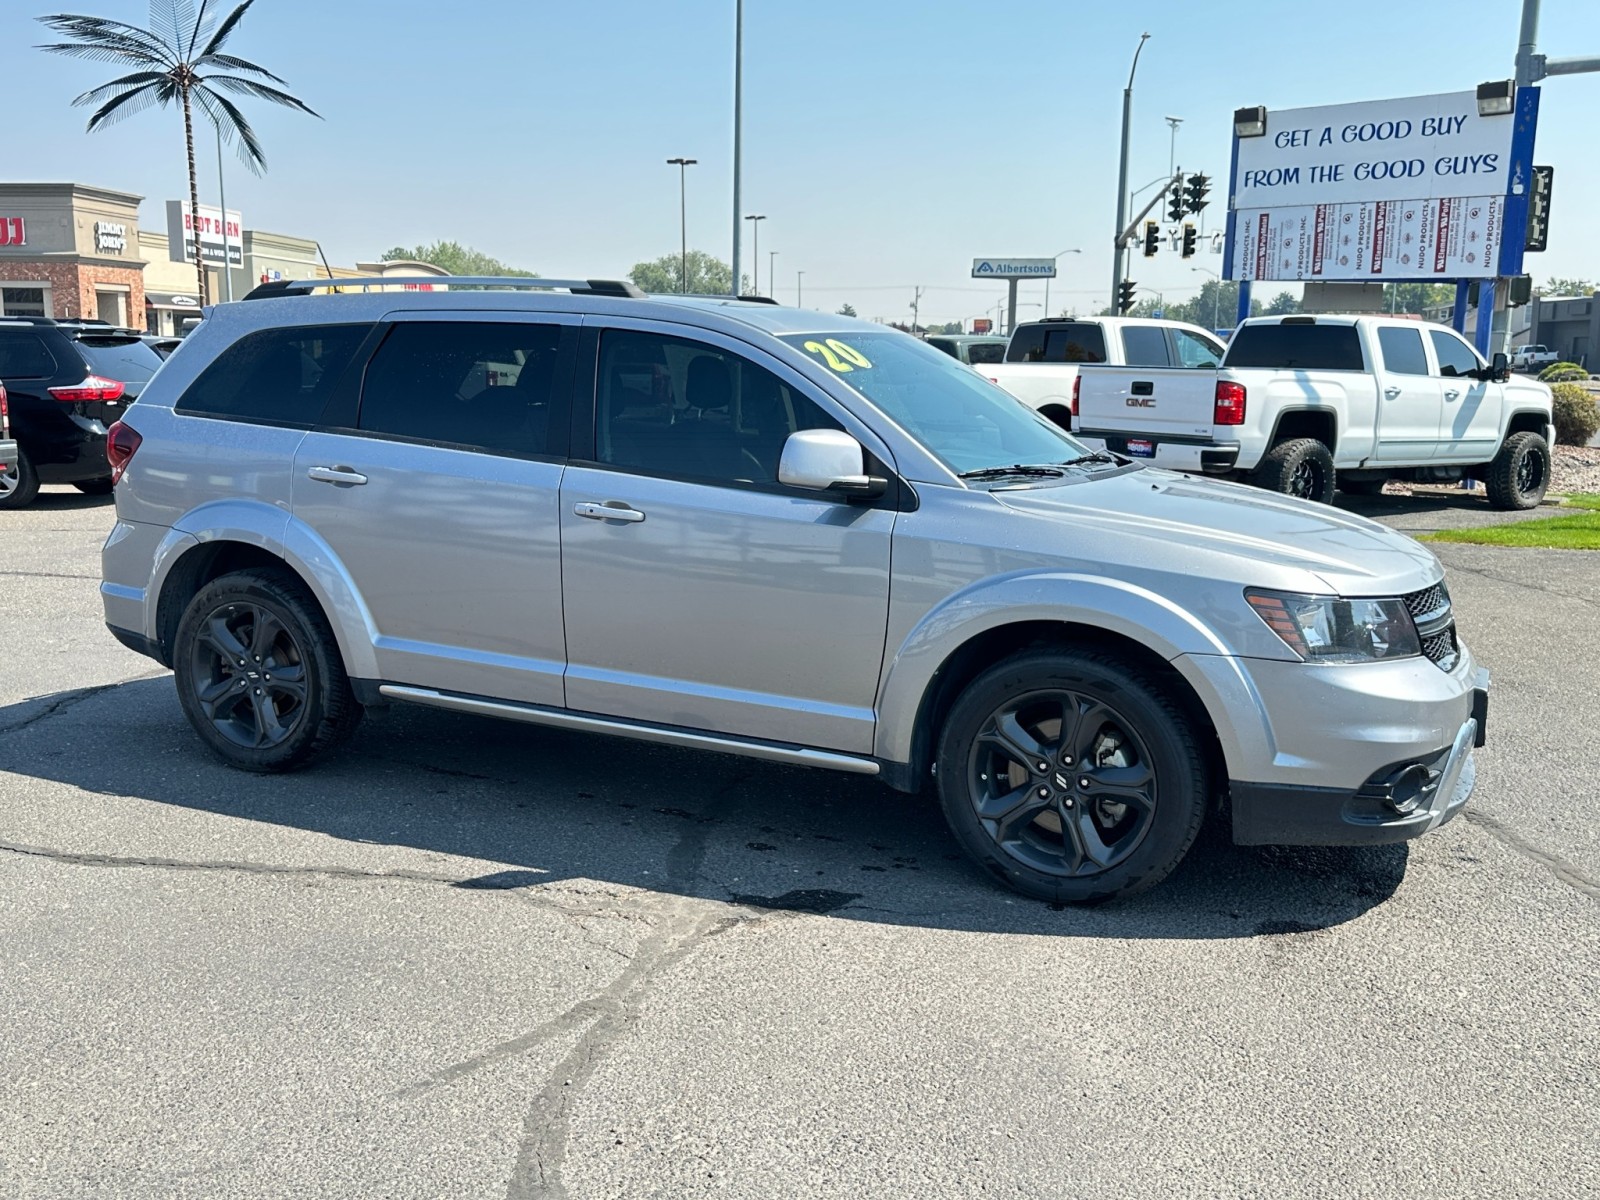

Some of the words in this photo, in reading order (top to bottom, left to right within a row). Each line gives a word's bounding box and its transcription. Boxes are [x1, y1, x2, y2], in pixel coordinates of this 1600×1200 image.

[1274, 128, 1312, 148] GET
[1319, 126, 1332, 147] A
[1342, 120, 1412, 143] GOOD
[1421, 115, 1468, 136] BUY
[1244, 167, 1300, 188] FROM
[1308, 164, 1344, 184] THE
[1354, 158, 1425, 181] GOOD
[1434, 154, 1498, 176] GUYS
[98, 221, 126, 235] JIMMY
[185, 214, 211, 233] BOT
[99, 235, 127, 249] JOHN'S
[1438, 228, 1448, 258] Elements
[1356, 247, 1364, 270] NUDO
[1418, 246, 1426, 269] NUDO
[1484, 244, 1492, 268] NUDO
[995, 264, 1052, 274] Albertsons
[804, 338, 872, 372] 20
[1126, 398, 1156, 408] GMC
